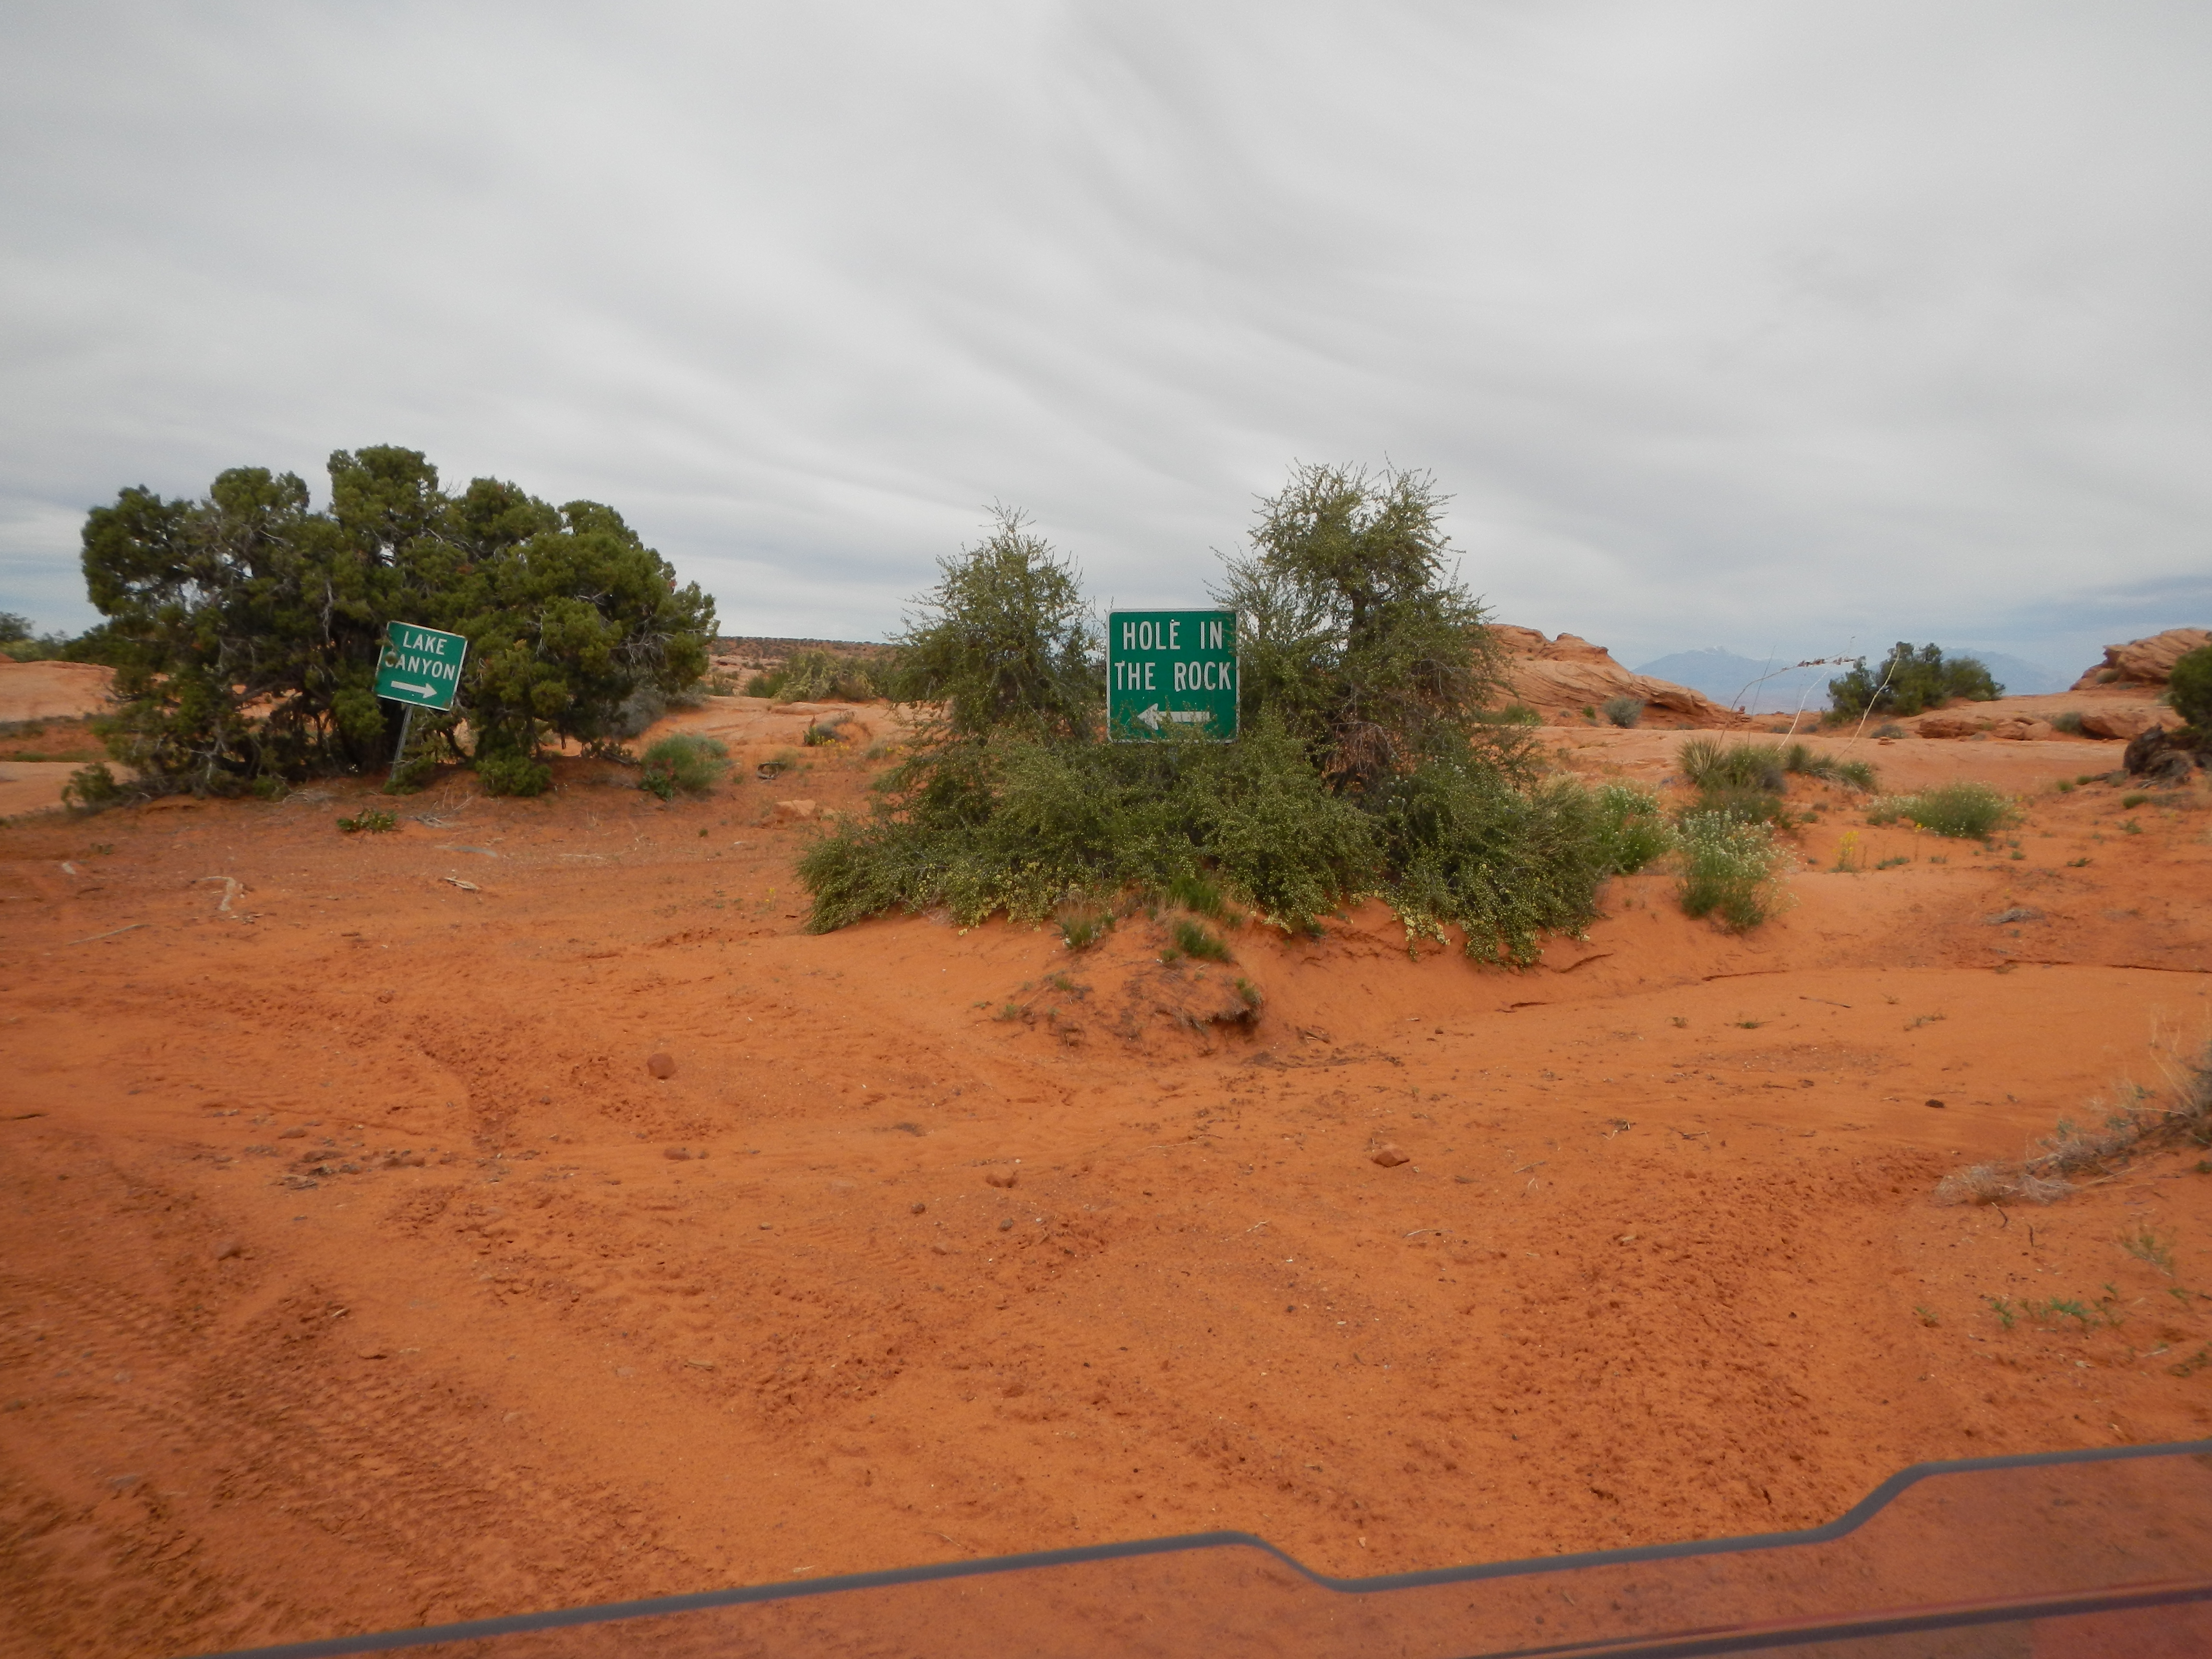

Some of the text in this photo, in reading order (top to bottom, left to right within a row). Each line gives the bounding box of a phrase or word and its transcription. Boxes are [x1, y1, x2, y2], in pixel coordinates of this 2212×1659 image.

[402, 631, 448, 655] LAKE
[1123, 621, 1222, 650] HOLE IN
[1114, 661, 1232, 691] THE ROCK
